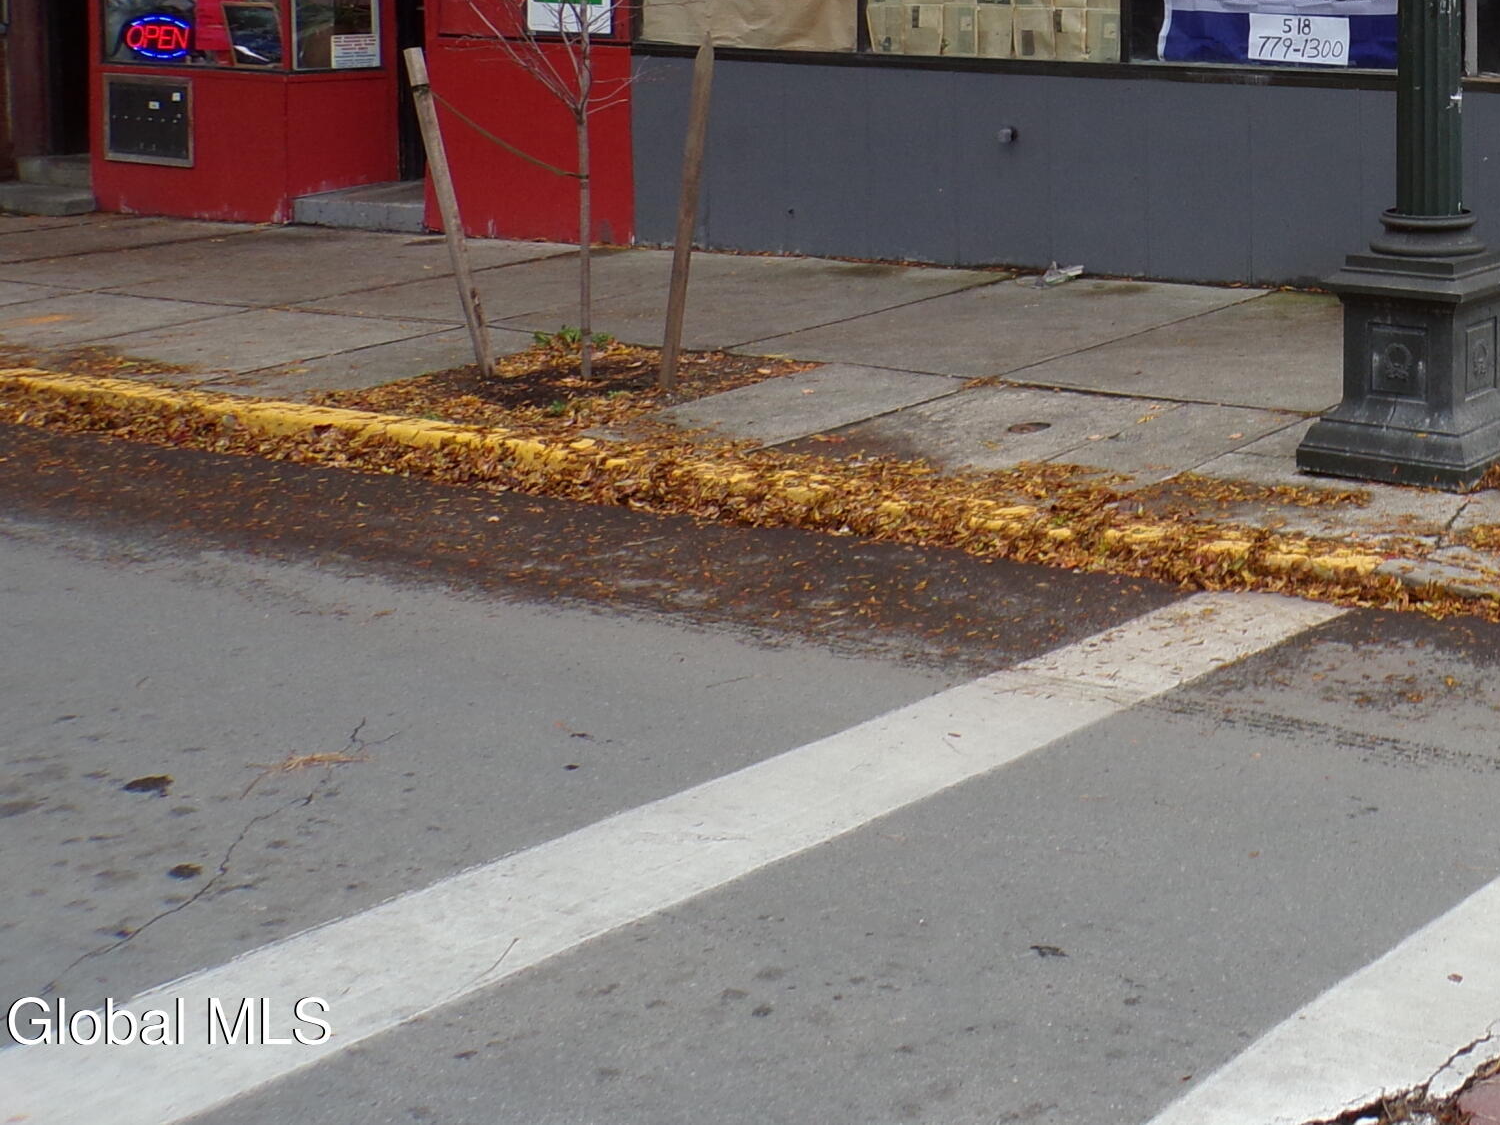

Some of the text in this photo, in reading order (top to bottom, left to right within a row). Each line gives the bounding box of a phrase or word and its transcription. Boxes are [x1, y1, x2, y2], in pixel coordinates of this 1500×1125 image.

[126, 25, 190, 50] OPEN
[1282, 17, 1312, 36] 518
[1257, 35, 1345, 60] 779-1300
